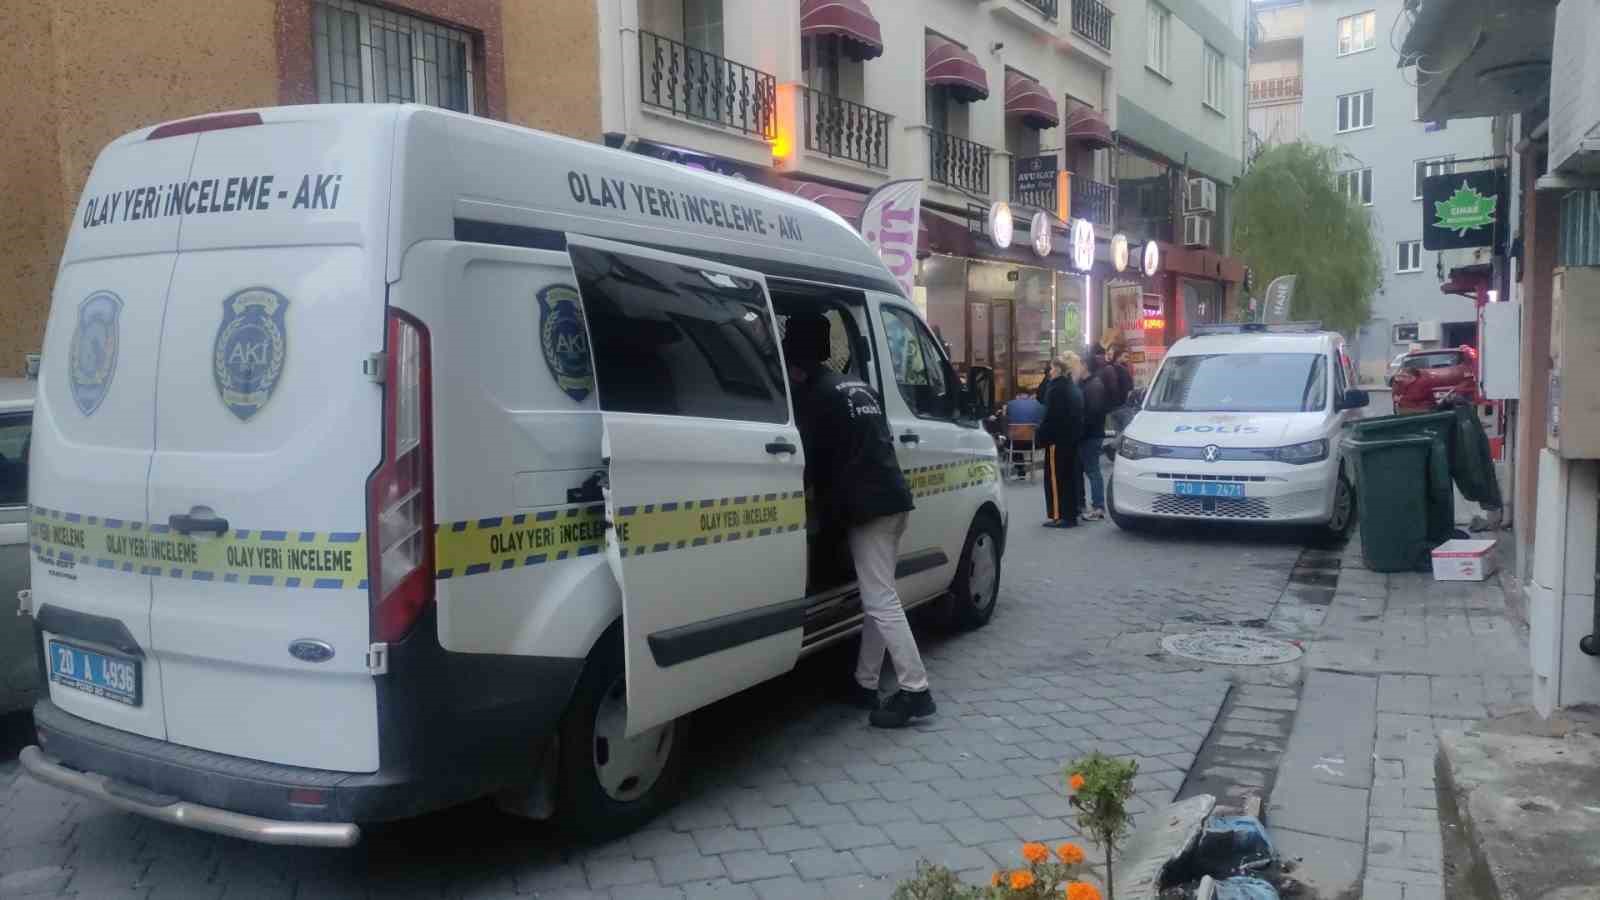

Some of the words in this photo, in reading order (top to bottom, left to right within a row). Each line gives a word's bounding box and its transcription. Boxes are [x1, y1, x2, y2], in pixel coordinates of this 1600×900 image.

[567, 171, 626, 210] OLAY
[83, 191, 122, 228] OLAY
[1176, 483, 1192, 494] 20
[700, 511, 721, 531] OLAY
[490, 531, 525, 554] OLAY
[227, 546, 255, 567] OLAY
[59, 648, 74, 674] 20
[103, 658, 135, 694] 4936
